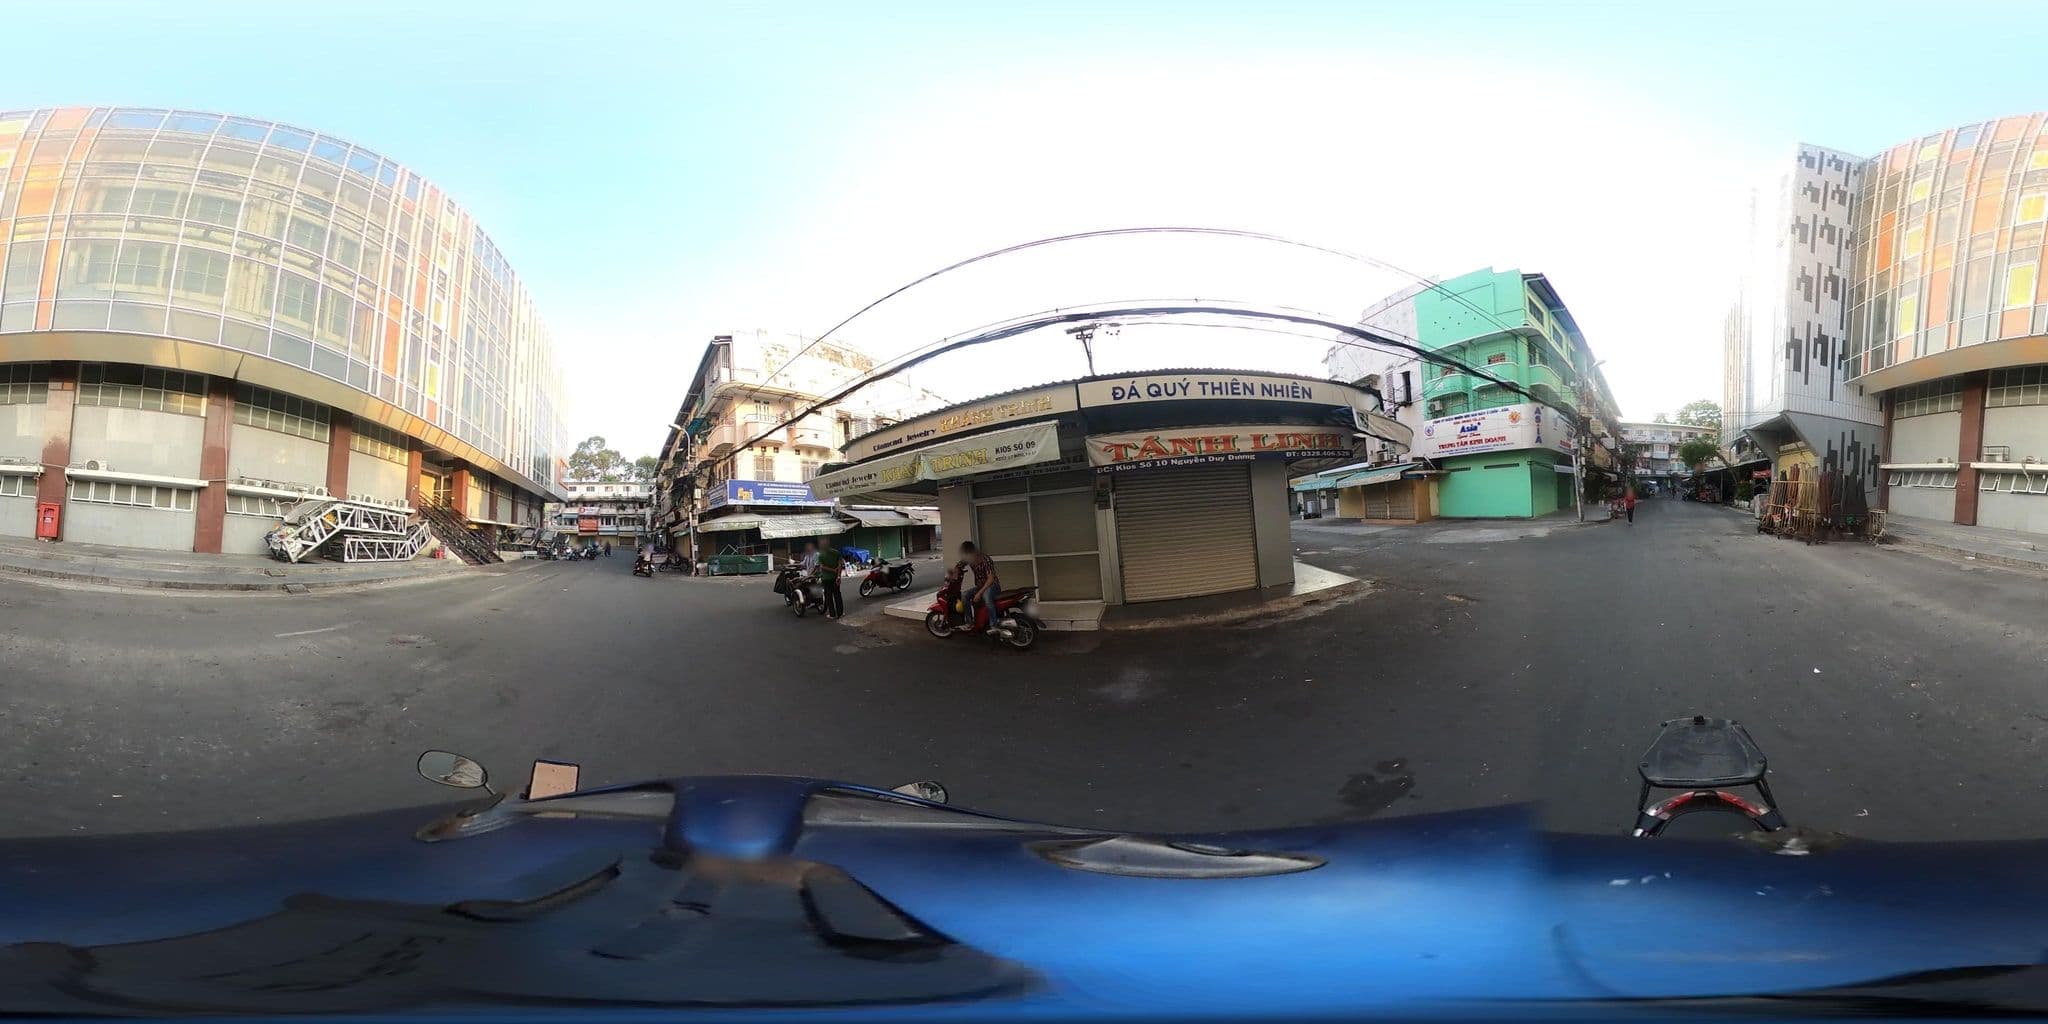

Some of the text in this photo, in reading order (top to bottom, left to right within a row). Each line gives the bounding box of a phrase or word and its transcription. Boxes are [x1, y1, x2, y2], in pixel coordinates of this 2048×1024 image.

[1111, 377, 1313, 400] ĐÁ QUÝ THIÊN NHIÊN
[906, 428, 937, 441] Jewelry
[995, 447, 1012, 455] KIOS
[1026, 440, 1036, 449] 09
[1156, 459, 1169, 467] 10
